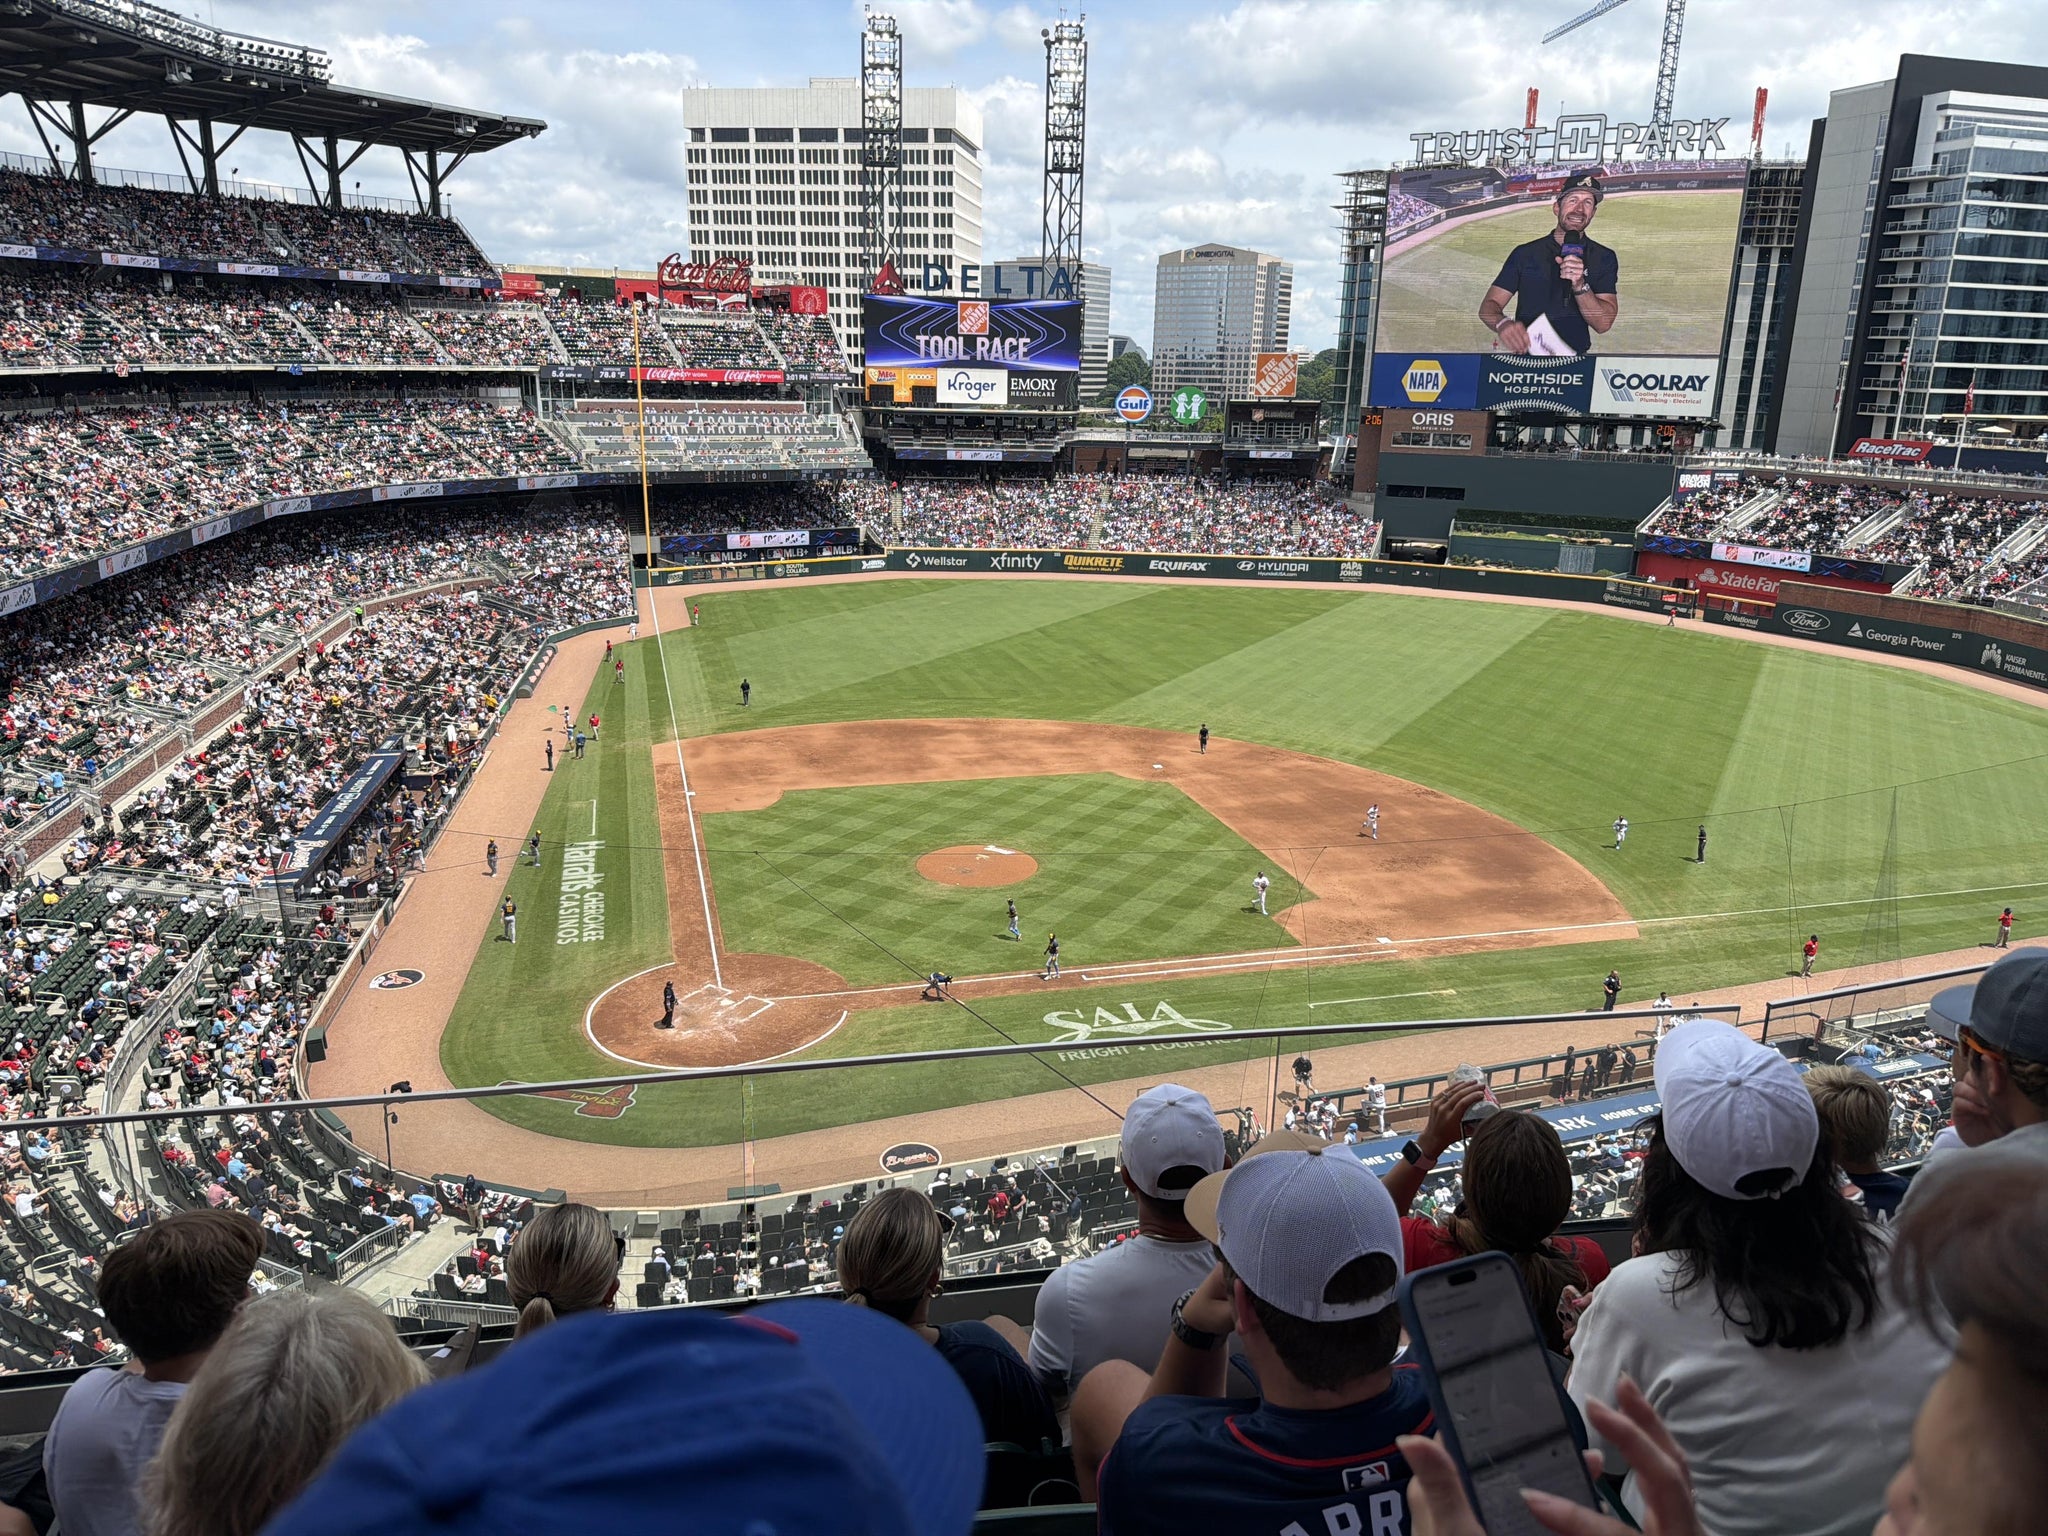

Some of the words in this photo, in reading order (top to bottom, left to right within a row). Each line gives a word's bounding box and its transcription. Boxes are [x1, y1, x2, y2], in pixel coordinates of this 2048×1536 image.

[1410, 127, 1547, 162] TRUIST
[1614, 117, 1731, 154] PARK
[658, 253, 757, 292] Coca-Cola
[923, 263, 1074, 295] DELTA
[959, 303, 989, 333] HOME
[963, 305, 974, 317] THE
[970, 316, 989, 334] DEPOT
[915, 335, 970, 360] TOOL
[976, 338, 1031, 361] RACE
[1261, 358, 1278, 375] THE
[599, 371, 616, 379] 78.8
[1255, 354, 1297, 395] HOME
[1408, 371, 1439, 391] NAPA
[1488, 373, 1583, 386] NORTHSIDE
[1610, 373, 1711, 391] COOLRAY
[948, 371, 997, 400] Kroger
[1010, 378, 1058, 391] EMORY
[1270, 371, 1296, 396] DEPOT
[1504, 385, 1564, 395] HOSPITAL
[1118, 398, 1150, 410] Gulf
[1365, 414, 1382, 426] 2:06
[1412, 412, 1454, 426] ORIS
[1656, 424, 1676, 437] 2:06
[1855, 442, 1921, 457] RaceTrac
[1679, 480, 1711, 489] VISION
[721, 552, 748, 562] MLB+
[833, 546, 858, 556] MLB+
[923, 556, 968, 567] Wellstar
[990, 552, 1042, 570] xfinity
[1063, 554, 1124, 567] QUIKRETE
[1149, 559, 1209, 573] EQUIFAX
[1258, 561, 1309, 572] HYUNDAI
[1340, 561, 1363, 571] PAPA
[1790, 611, 1822, 628] Ford
[1866, 629, 1908, 647] Georgia
[1910, 636, 1945, 652] Power
[2005, 653, 2027, 666] KAISER
[2003, 663, 2047, 682] PERMANENTE
[557, 893, 581, 945] CASINOS
[582, 891, 605, 943] CHEROKEE
[1600, 1107, 1640, 1121] HOME
[1549, 1114, 1597, 1134] ARK
